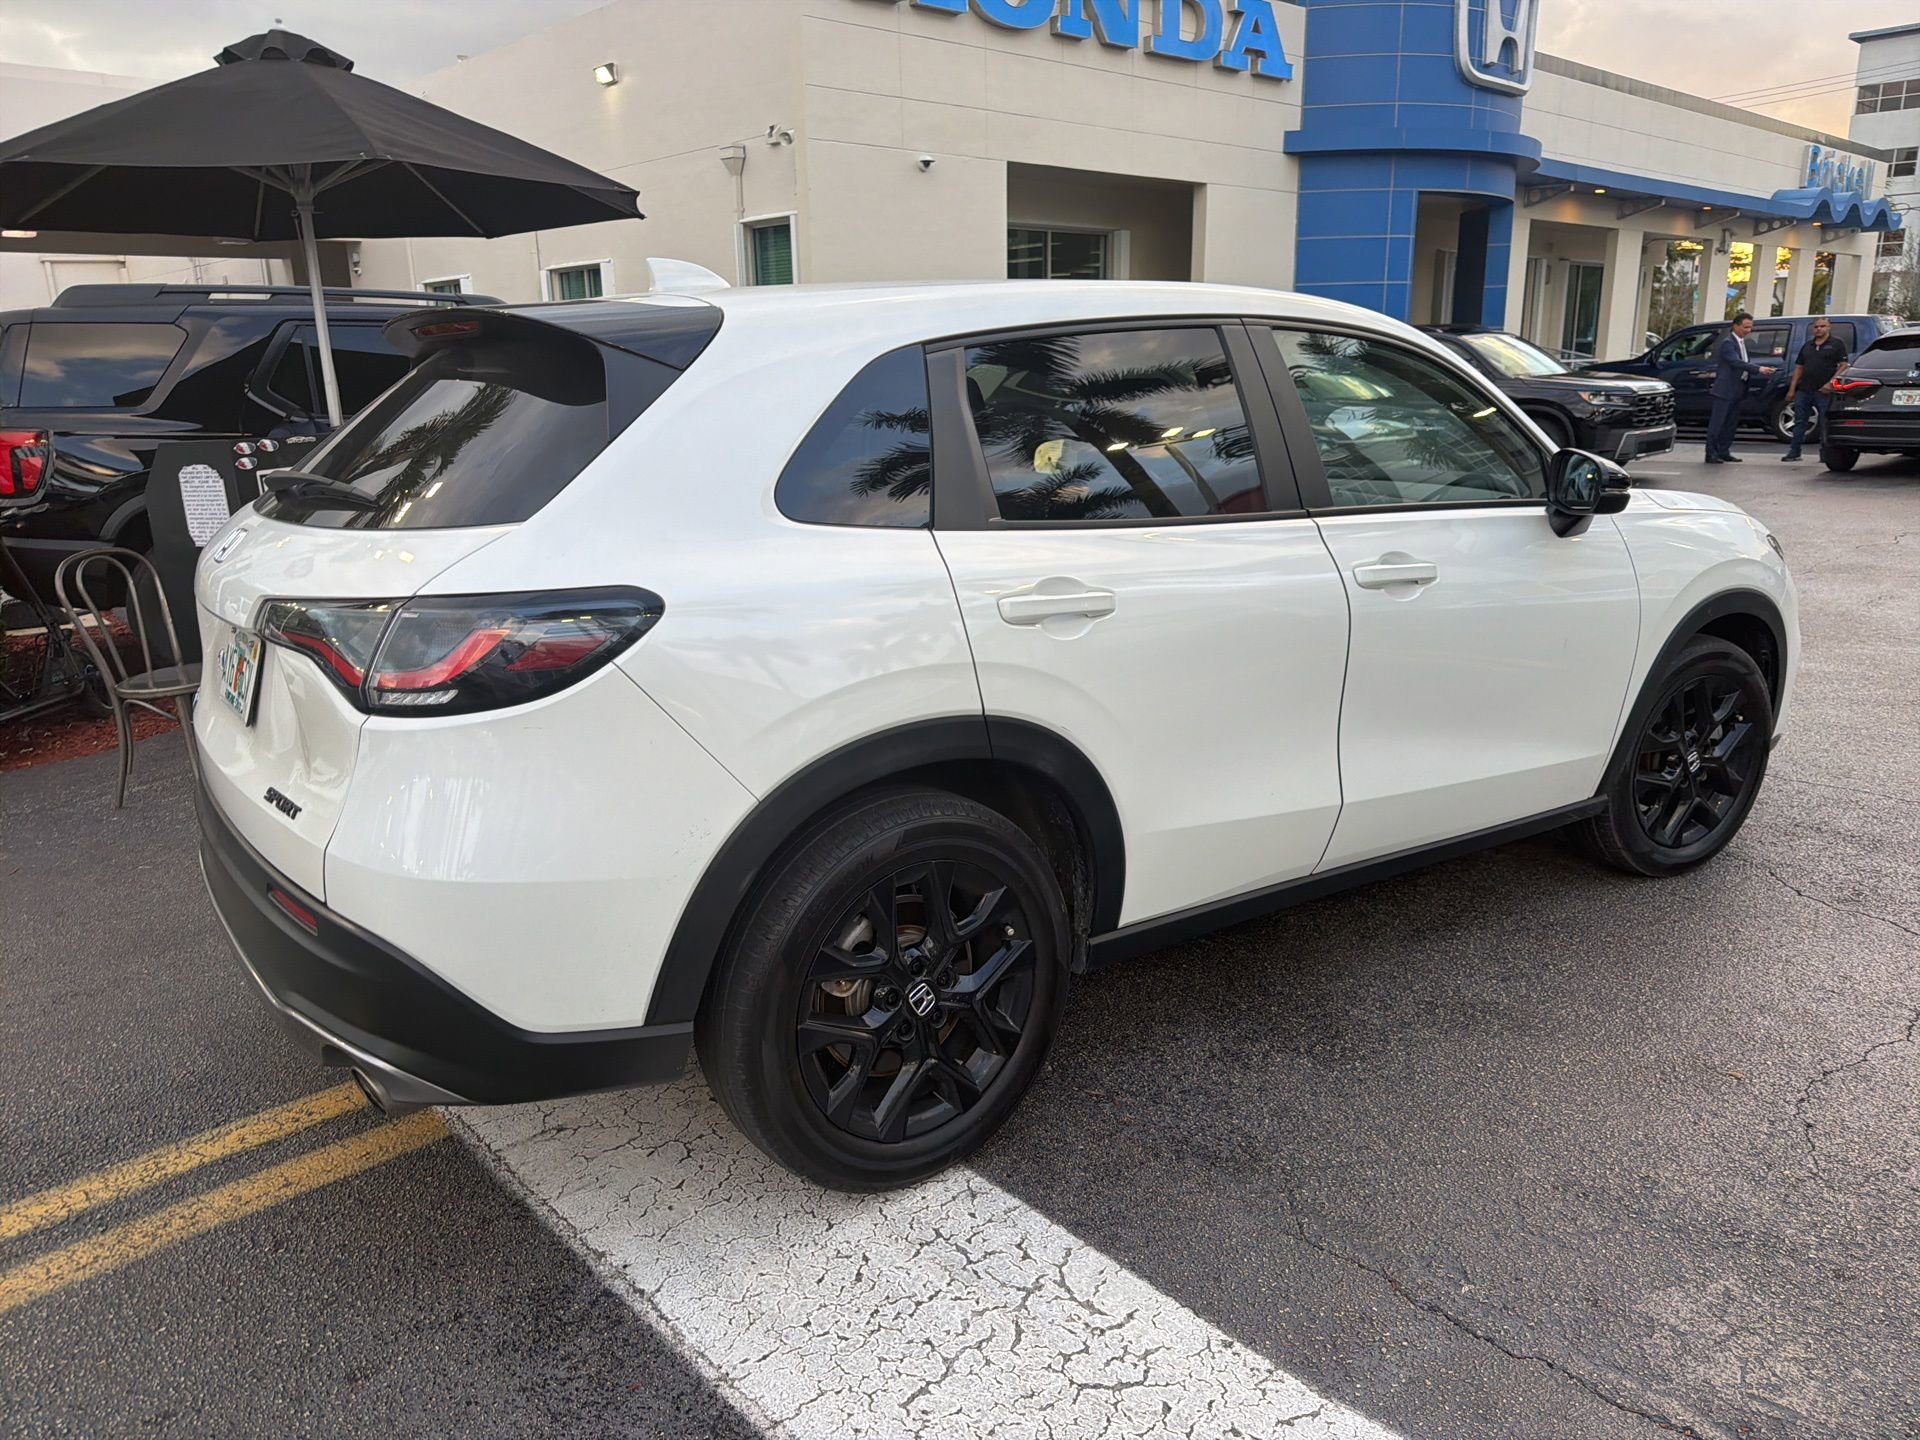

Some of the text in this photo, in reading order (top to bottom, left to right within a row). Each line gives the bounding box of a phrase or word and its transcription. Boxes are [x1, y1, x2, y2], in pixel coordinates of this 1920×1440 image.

[868, 0, 1292, 82] NDA
[1801, 144, 1876, 200] Brickell
[263, 786, 303, 821] SPORT
